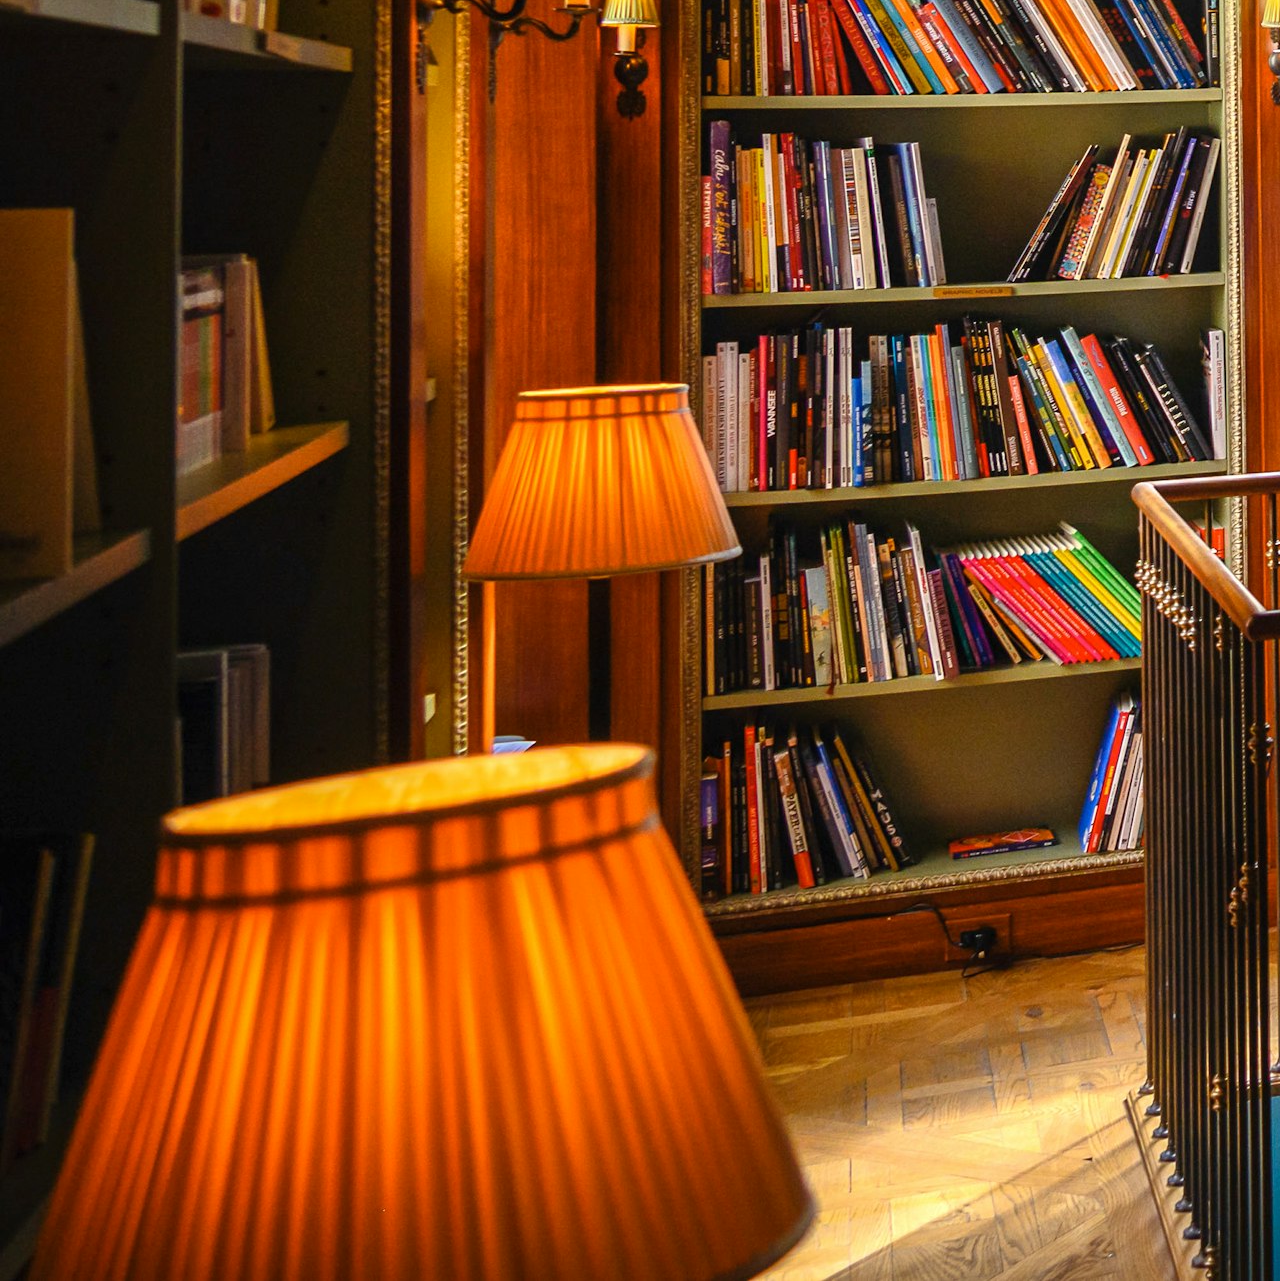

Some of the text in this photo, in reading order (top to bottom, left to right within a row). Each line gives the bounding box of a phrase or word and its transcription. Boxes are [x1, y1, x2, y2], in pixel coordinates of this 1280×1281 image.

[1015, 3, 1030, 24] Louvre
[839, 5, 878, 78] ALCOOLIQUE
[766, 389, 777, 438] WANNSEE
[1158, 383, 1191, 435] ESSENCE
